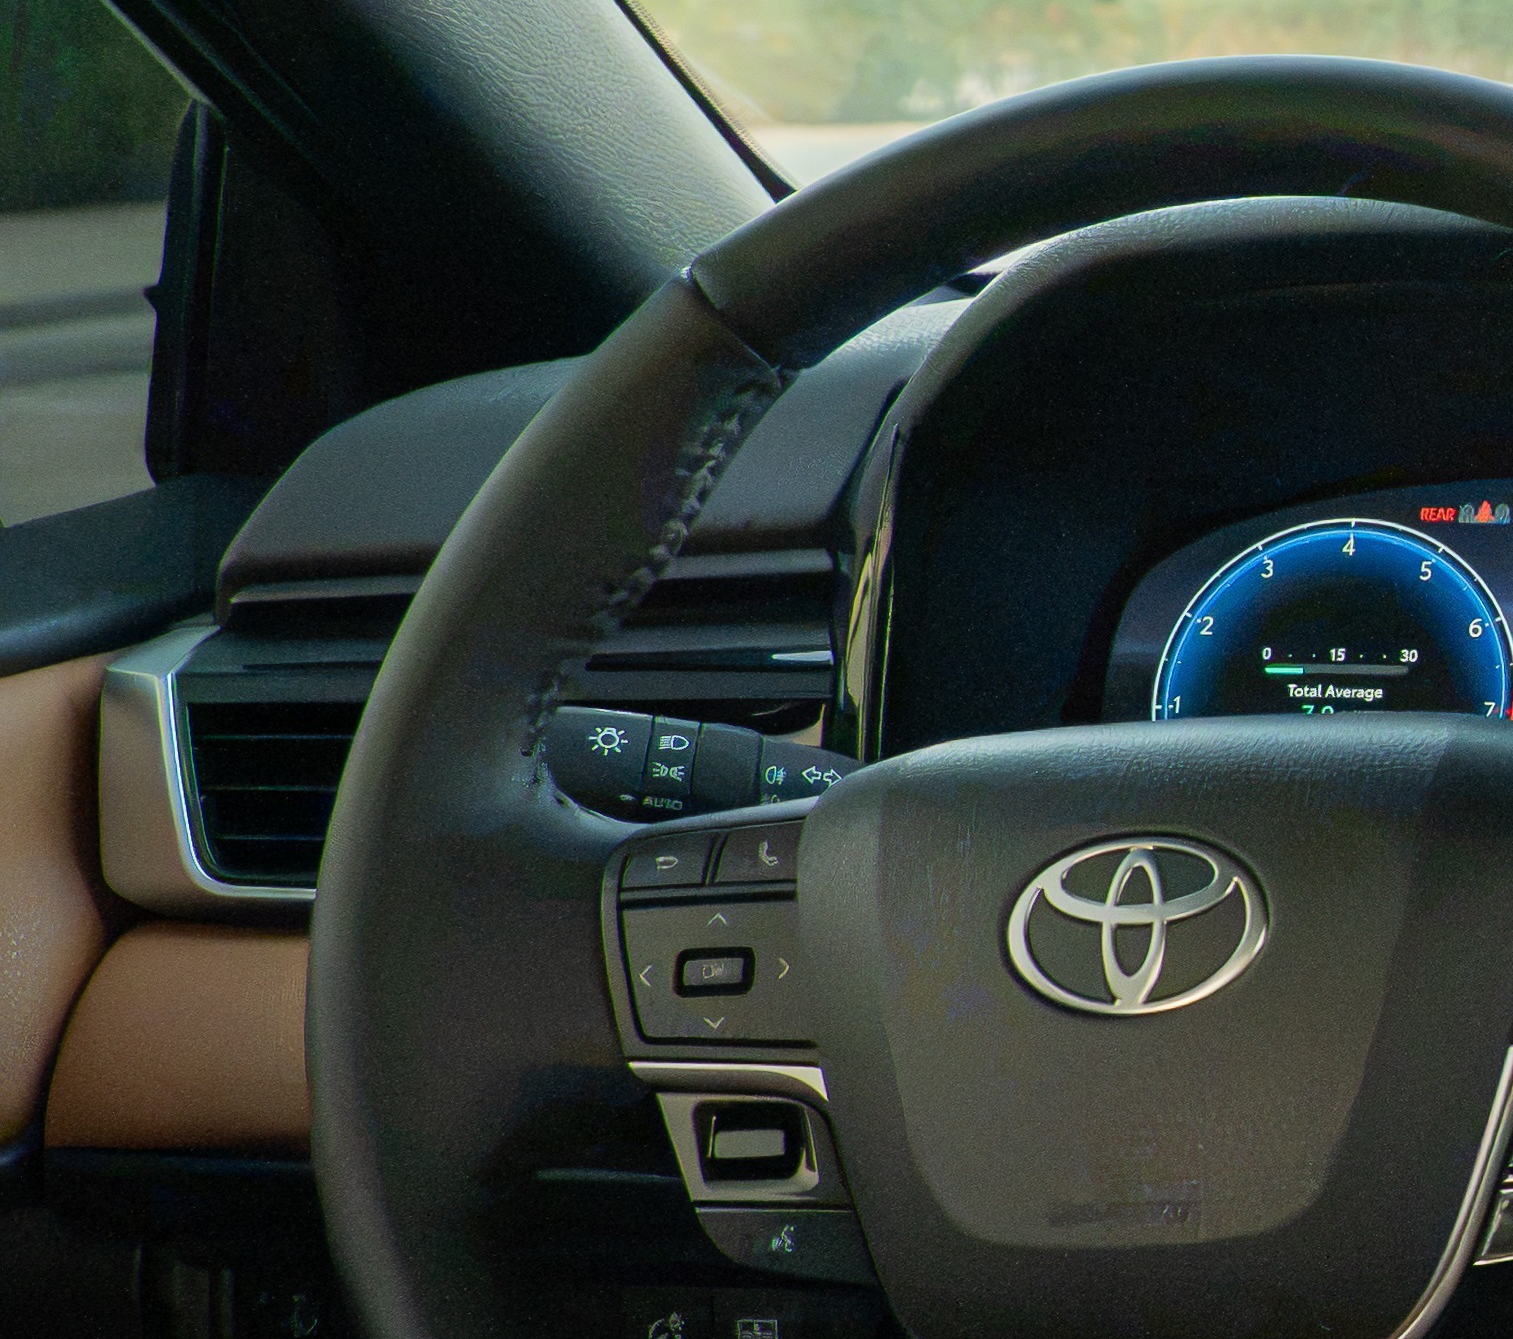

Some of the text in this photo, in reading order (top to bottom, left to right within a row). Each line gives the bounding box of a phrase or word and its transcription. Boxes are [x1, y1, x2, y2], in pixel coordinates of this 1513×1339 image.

[1420, 506, 1457, 522] REAR
[1341, 538, 1356, 557] 4
[1260, 559, 1274, 579] 3
[1419, 560, 1433, 581] 5
[1200, 616, 1214, 636] 2
[1469, 617, 1483, 639] 6
[1262, 647, 1272, 660] 0
[1330, 648, 1346, 661] 15
[1400, 649, 1418, 663] 30
[1287, 684, 1384, 702] Total Average
[1171, 696, 1182, 715] 1
